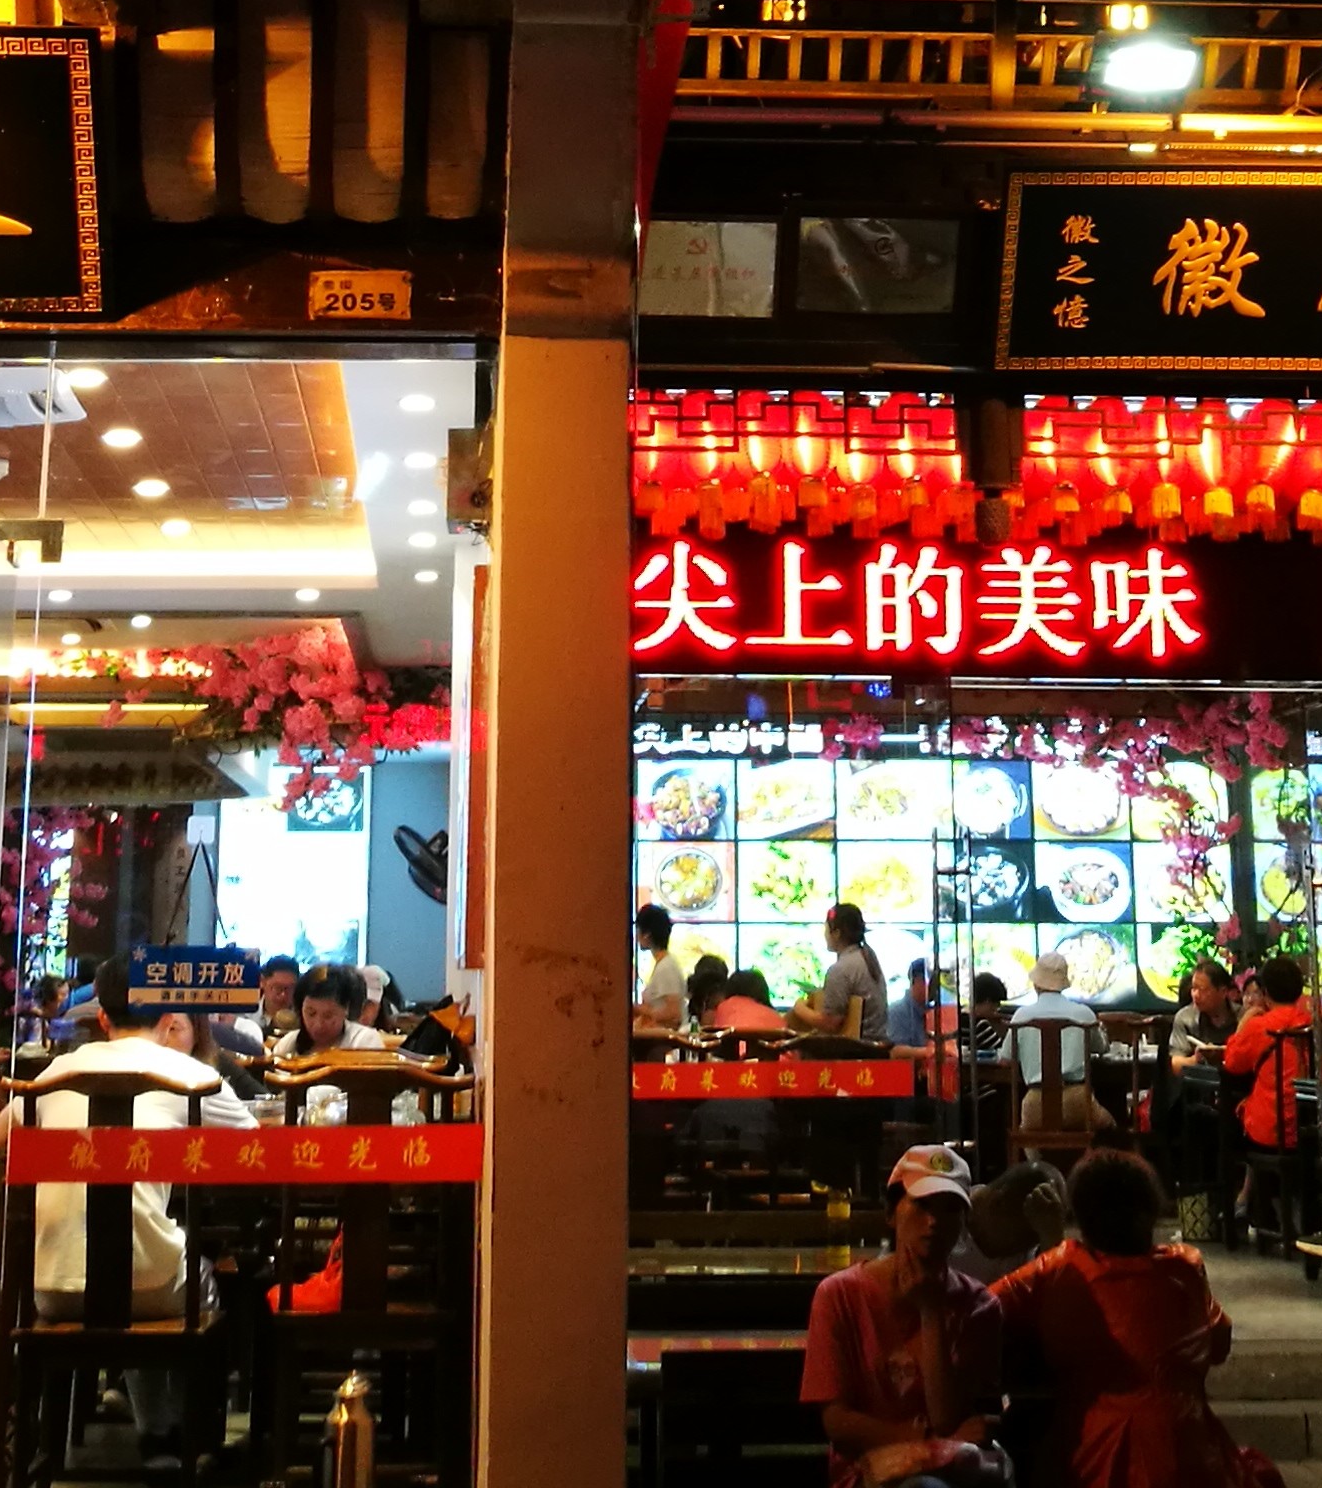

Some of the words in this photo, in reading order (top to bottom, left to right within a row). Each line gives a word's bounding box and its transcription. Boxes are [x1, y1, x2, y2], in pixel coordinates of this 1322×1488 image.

[325, 292, 396, 312] 205号
[633, 541, 1201, 658] 尖上的美味
[146, 962, 245, 985] 空调开放
[69, 1133, 433, 1172] 徽府菜欢迎光临
